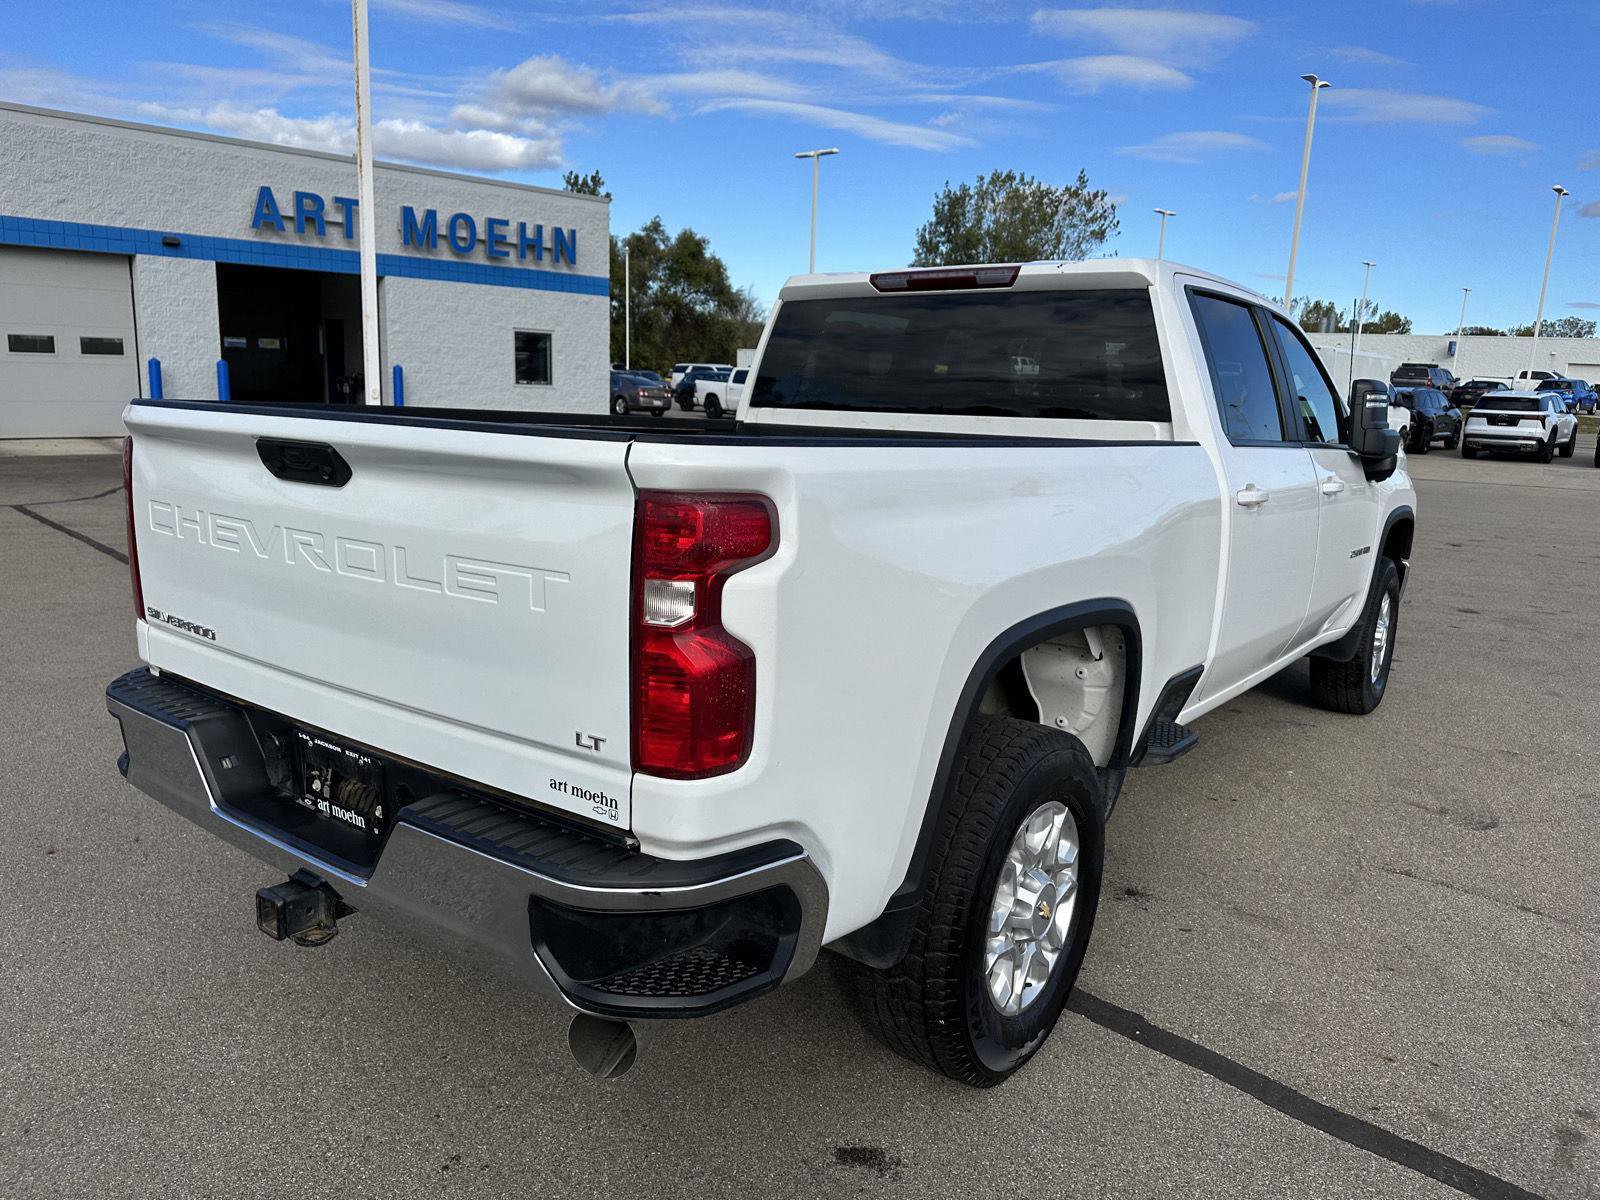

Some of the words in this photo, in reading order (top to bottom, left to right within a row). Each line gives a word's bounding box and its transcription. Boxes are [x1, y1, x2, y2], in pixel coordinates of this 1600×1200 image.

[251, 186, 360, 240] ART
[402, 206, 577, 265] MOEHN
[148, 499, 571, 612] CHEVROLET
[147, 606, 217, 641] SILVERADO
[576, 731, 607, 752] LT
[549, 778, 568, 793] art
[571, 785, 618, 810] moehn
[317, 798, 330, 814] art
[332, 804, 366, 828] moehn
